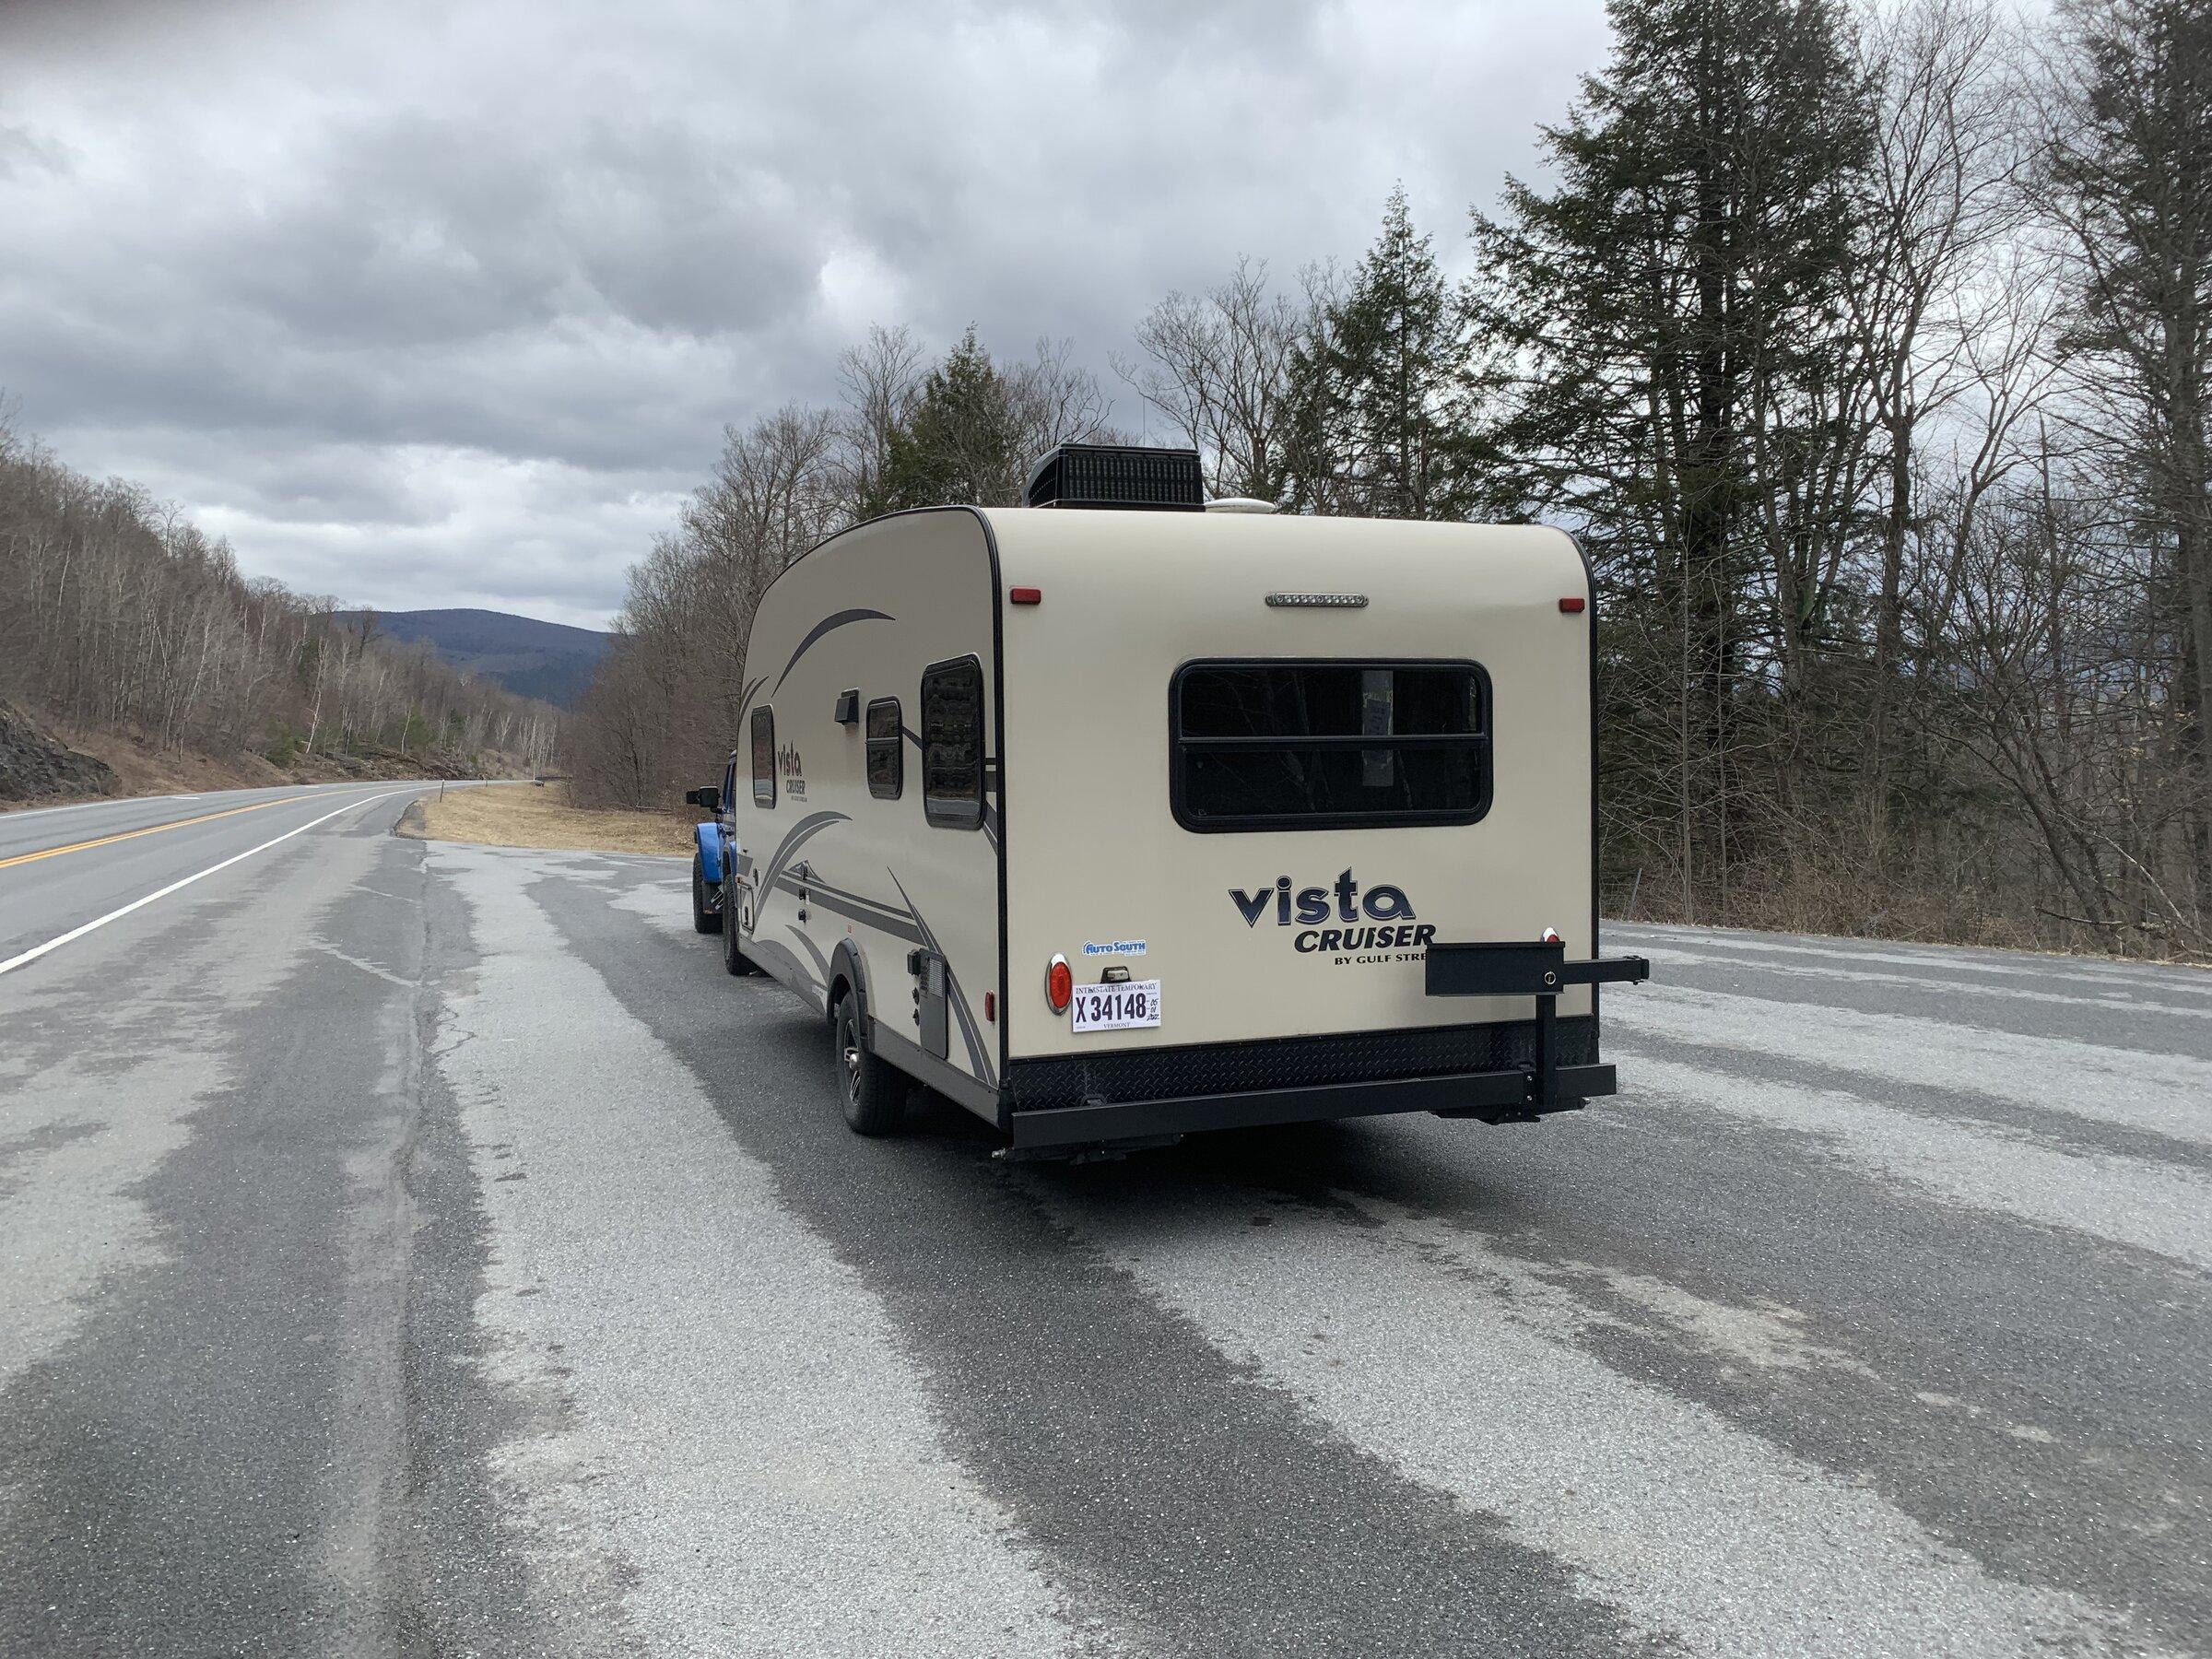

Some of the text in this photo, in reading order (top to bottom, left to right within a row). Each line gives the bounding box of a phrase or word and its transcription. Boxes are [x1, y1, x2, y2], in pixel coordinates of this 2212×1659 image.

[777, 739, 802, 776] vista
[1229, 866, 1416, 928] vista
[1294, 924, 1436, 952] CRUISER
[1335, 953, 1427, 965] BY GULF STRE
[1116, 982, 1157, 992] TEMPORARY
[1076, 993, 1147, 1022] X 34148
